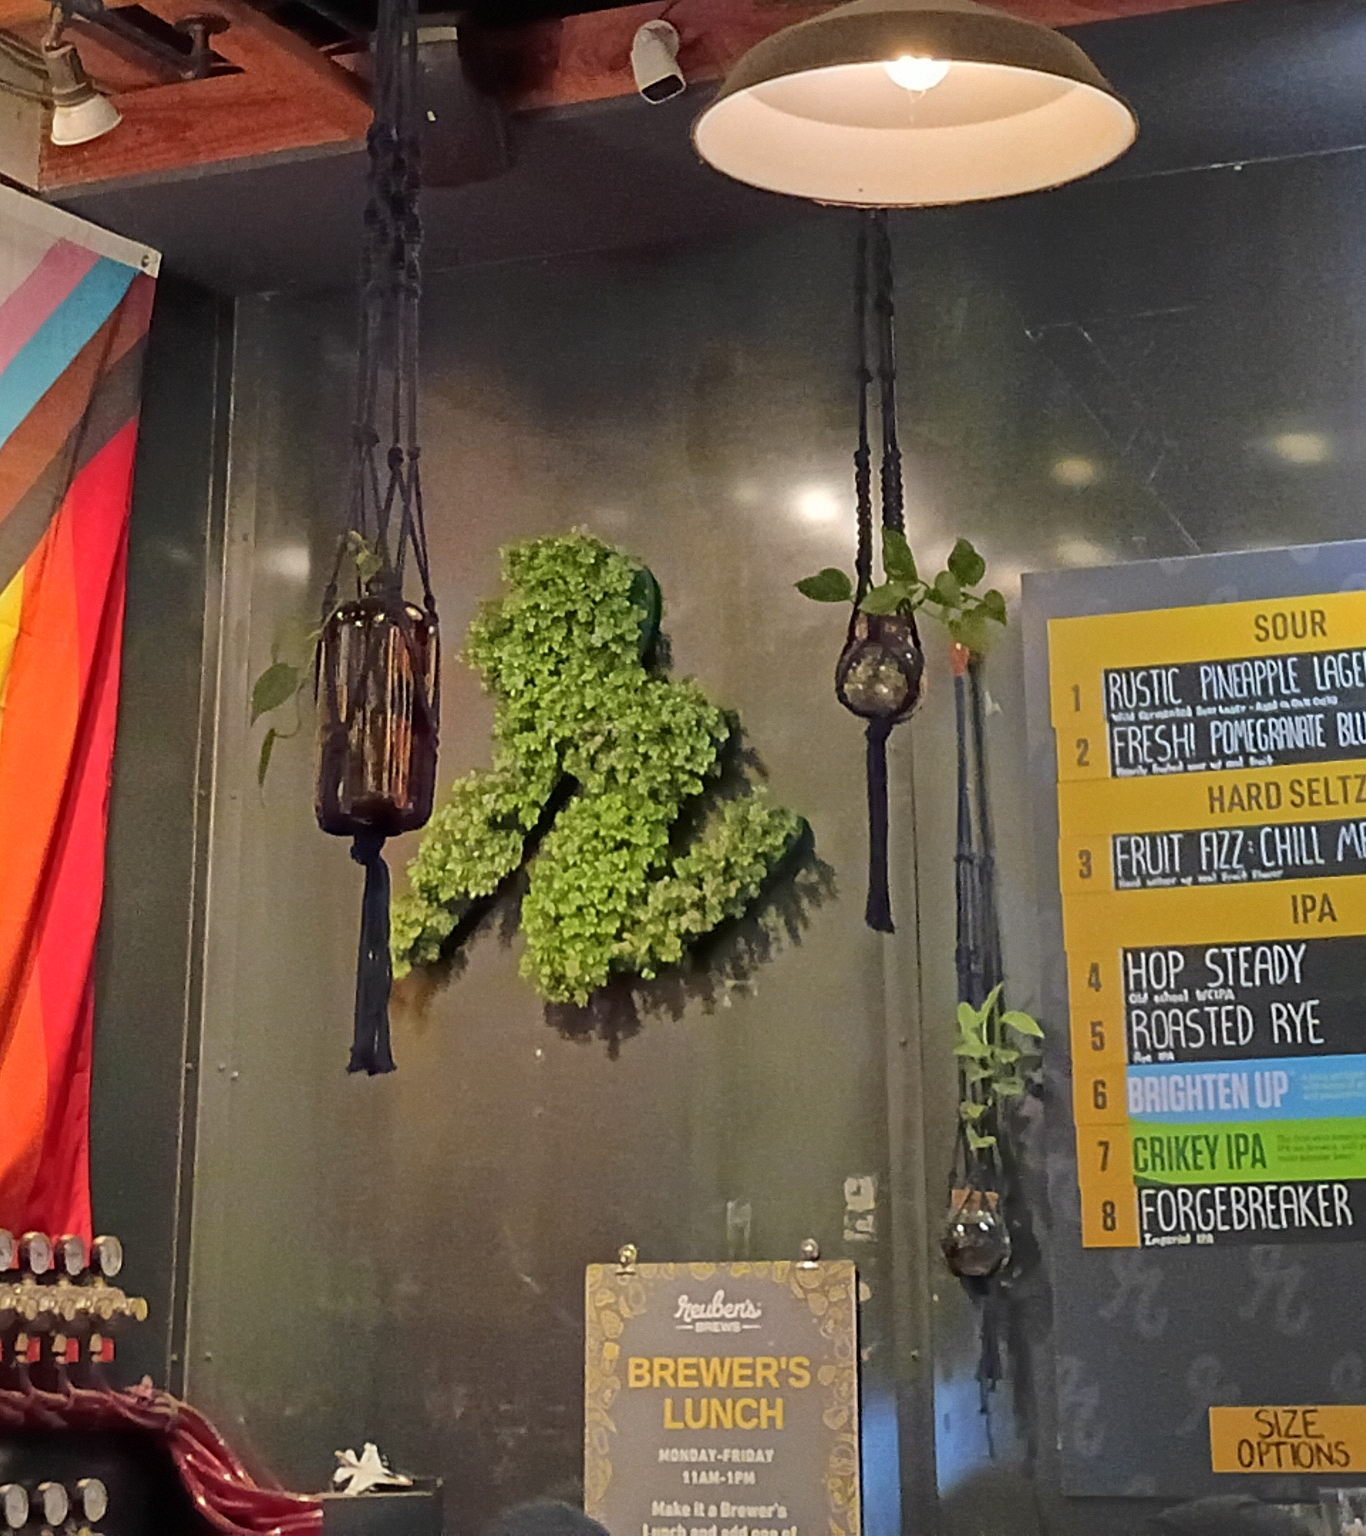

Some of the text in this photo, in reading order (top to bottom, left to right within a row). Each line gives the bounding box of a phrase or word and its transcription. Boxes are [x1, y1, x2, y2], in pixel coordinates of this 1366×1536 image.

[1255, 610, 1326, 642] SOUR
[1072, 684, 1082, 712] 1
[1109, 667, 1183, 710] RUSTIC
[1200, 657, 1301, 701] PINEAPPLE
[1077, 738, 1090, 766] 2
[1114, 722, 1196, 766] FRESH!
[1211, 713, 1326, 756] POMEGRANATE
[1208, 781, 1281, 814] HARD
[1079, 849, 1092, 879] 3
[1116, 833, 1184, 877] FRUIT
[1260, 825, 1326, 868] CHILL
[1291, 892, 1337, 925] IPA
[1088, 962, 1102, 992] 4
[1127, 950, 1185, 991] HOP
[1205, 943, 1307, 988] STEADY
[1090, 1020, 1105, 1052] 5
[1131, 1004, 1254, 1050] ROASTED
[1270, 999, 1325, 1045] RYE
[1092, 1078, 1107, 1110] 6
[1128, 1073, 1251, 1114] BRIGHTEN
[1255, 1070, 1289, 1108] UP
[1097, 1140, 1110, 1172] 7
[1133, 1133, 1220, 1173] CRIKEY
[1226, 1132, 1267, 1170] IPA
[1101, 1200, 1117, 1232] 8
[1141, 1182, 1353, 1232] FORGEBREAKER
[674, 1289, 762, 1322] Reuben's
[695, 1322, 742, 1334] BREWS
[628, 1356, 812, 1388] BREWER'S
[663, 1398, 785, 1429] LUNCH
[1254, 1408, 1326, 1439] SIZE
[658, 1448, 775, 1463] MONDAY-FRIDAY
[1237, 1438, 1351, 1469] OPTIONS
[683, 1470, 756, 1485] 11AM-1PM
[651, 1500, 691, 1517] Make
[720, 1501, 788, 1519] Brewer's
